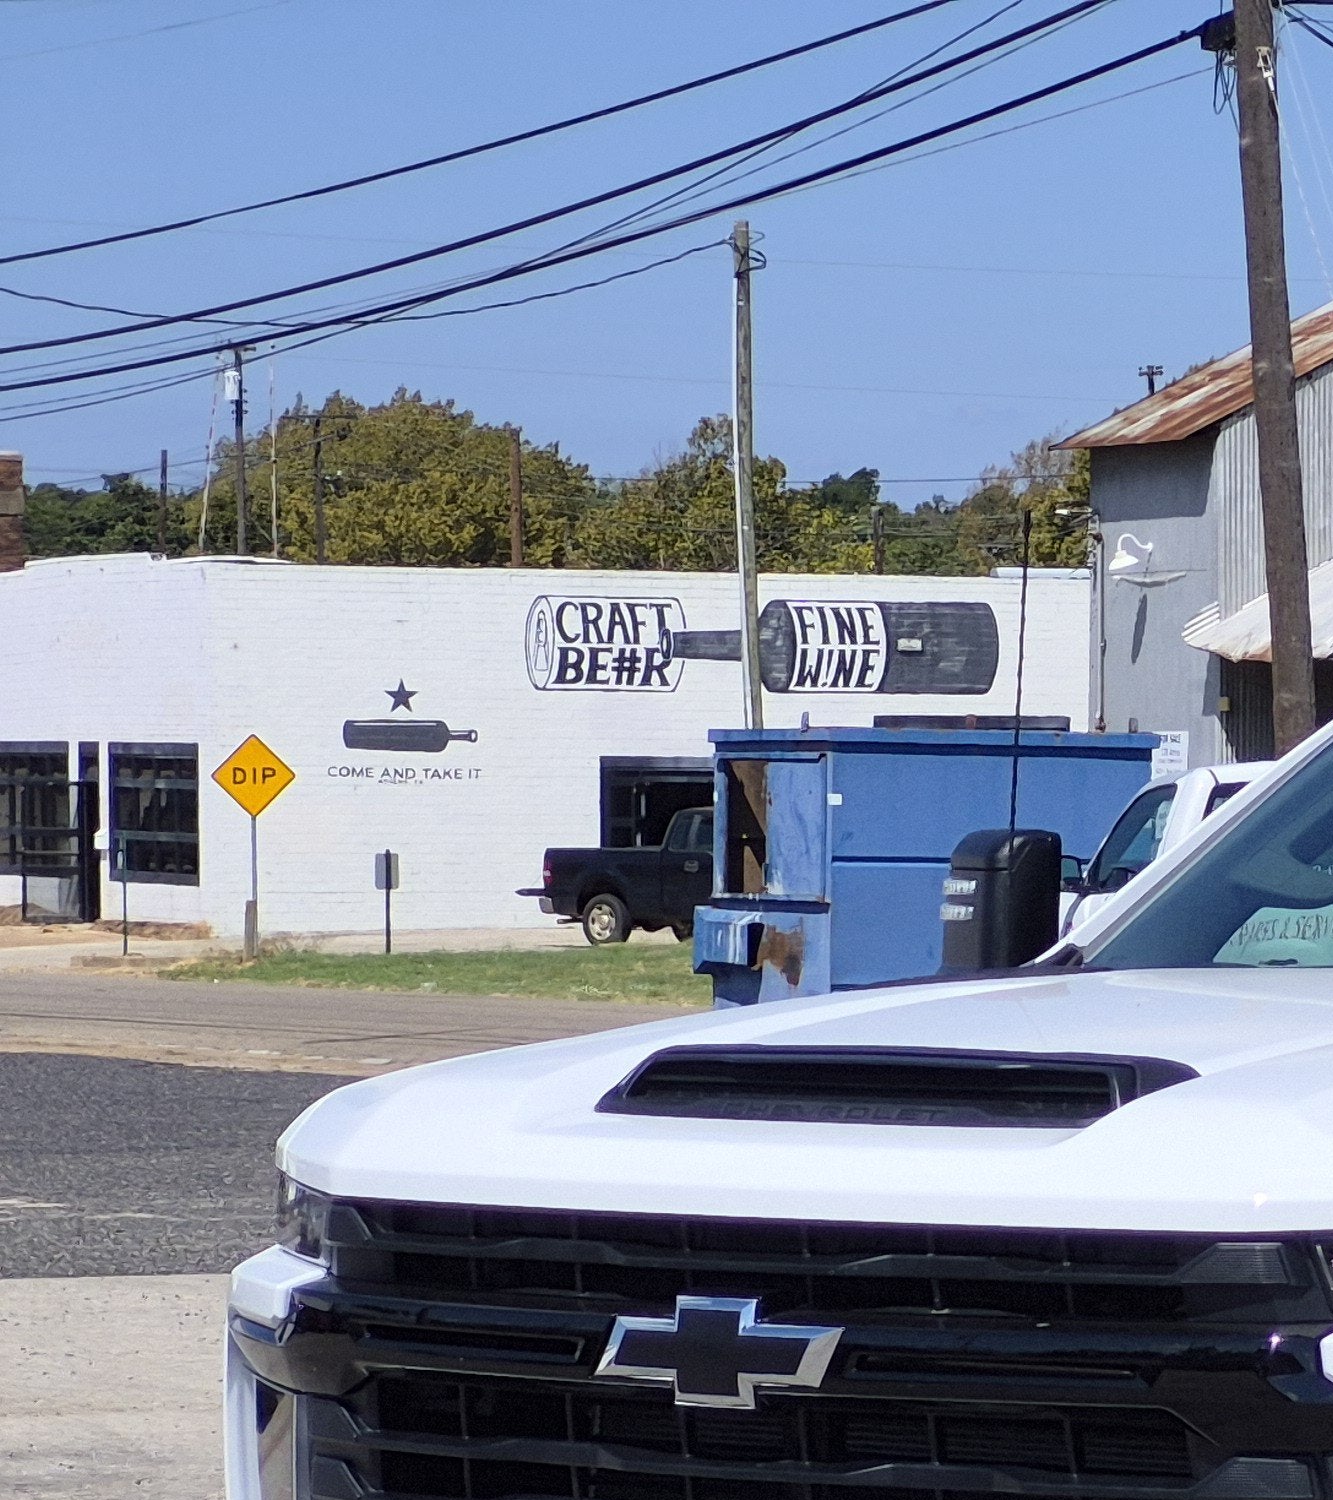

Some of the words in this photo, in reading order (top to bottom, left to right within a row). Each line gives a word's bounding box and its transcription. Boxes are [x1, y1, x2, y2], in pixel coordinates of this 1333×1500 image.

[555, 601, 673, 645] CRAFT
[792, 606, 880, 645] FINE
[551, 646, 672, 687] BE#R
[232, 766, 277, 785] DIP
[327, 765, 374, 778] COME
[381, 767, 416, 780] AND
[422, 768, 463, 780] TAKE
[468, 768, 482, 780] IT
